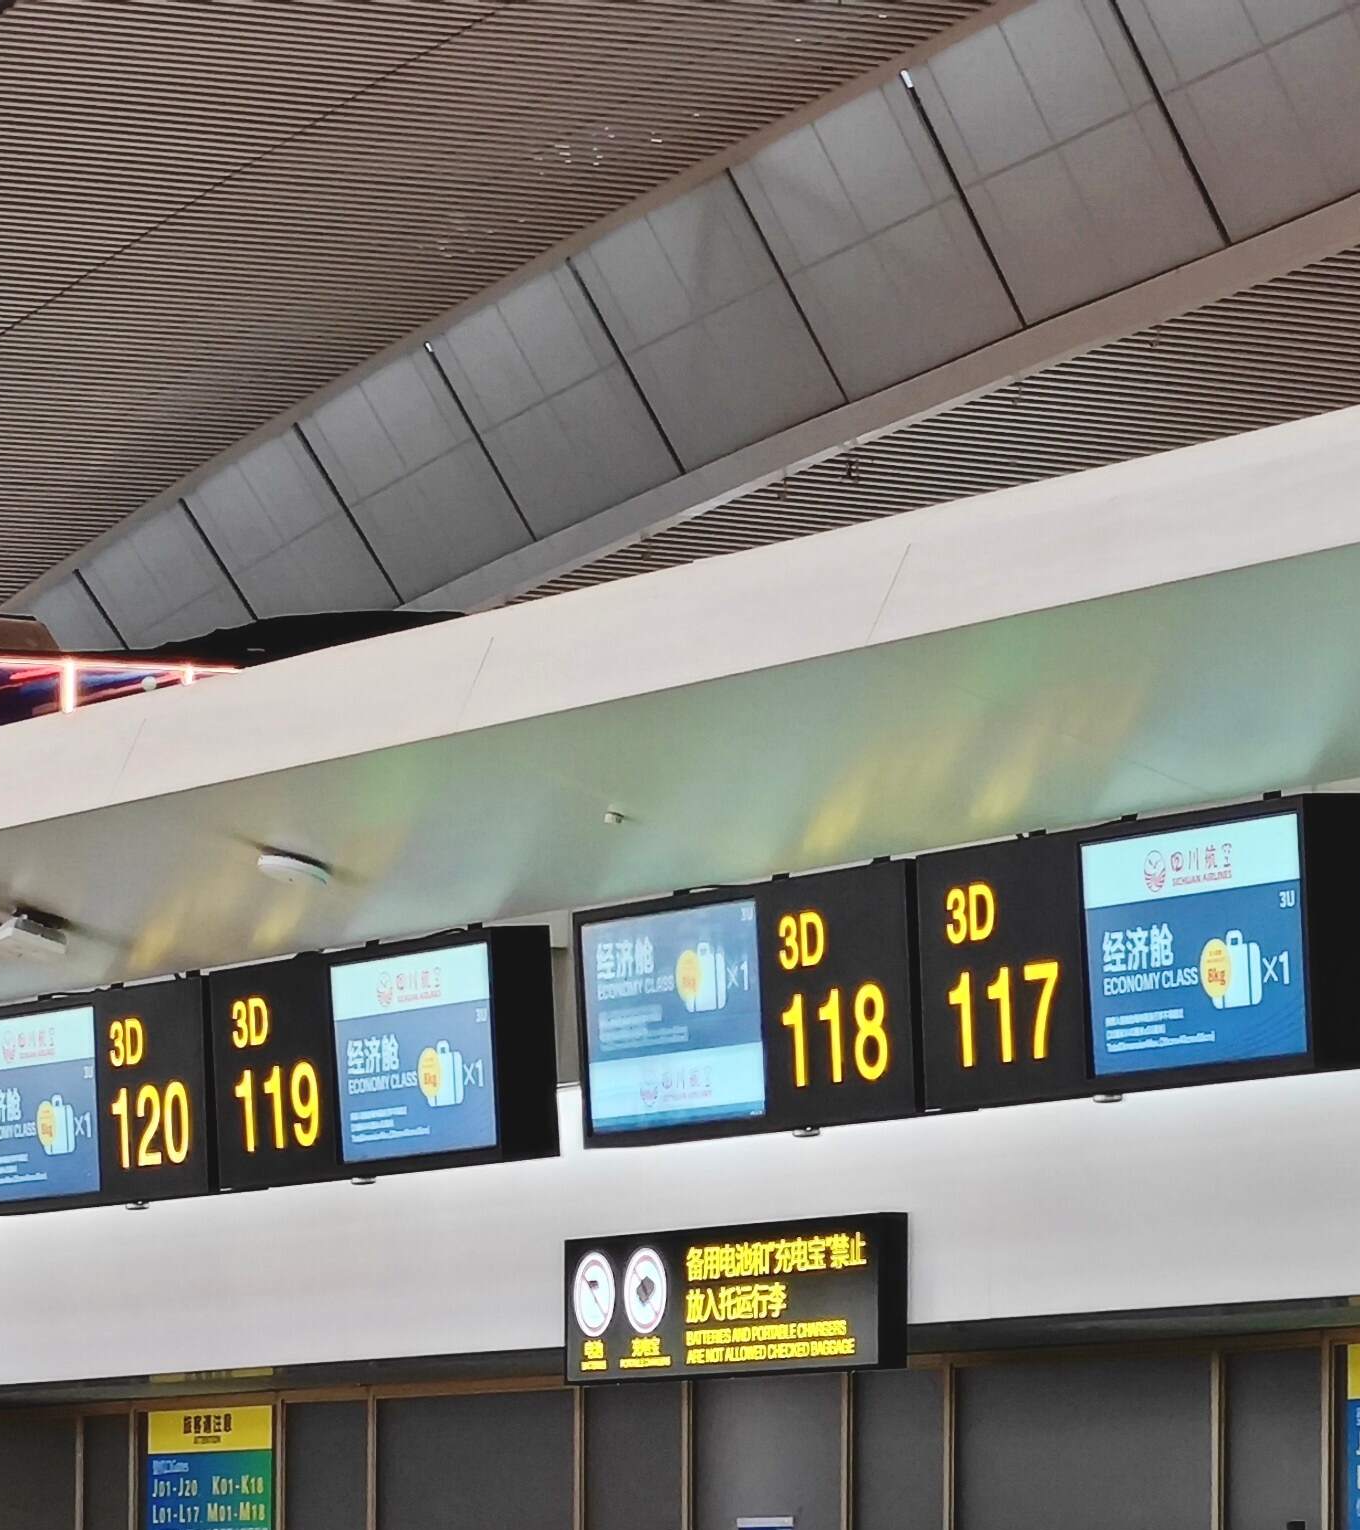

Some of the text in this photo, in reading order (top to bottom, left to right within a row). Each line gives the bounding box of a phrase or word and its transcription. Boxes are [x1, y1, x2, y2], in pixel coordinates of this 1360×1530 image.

[1171, 843, 1234, 873] 四川航空
[945, 884, 995, 944] 3D
[1279, 890, 1295, 909] 3U
[596, 936, 655, 980] 经济舱
[778, 911, 825, 971] 3D
[1102, 923, 1174, 972] 经济舱
[1104, 966, 1199, 996] ECONOMY CLASS
[231, 998, 269, 1047] 3D
[782, 983, 889, 1086] 118
[948, 961, 1060, 1068] 117
[109, 1018, 143, 1067] 3D
[346, 1034, 400, 1075] 经济舱
[111, 1081, 189, 1170] 120
[234, 1061, 320, 1153] 119
[686, 1282, 787, 1323] 放入托运行李
